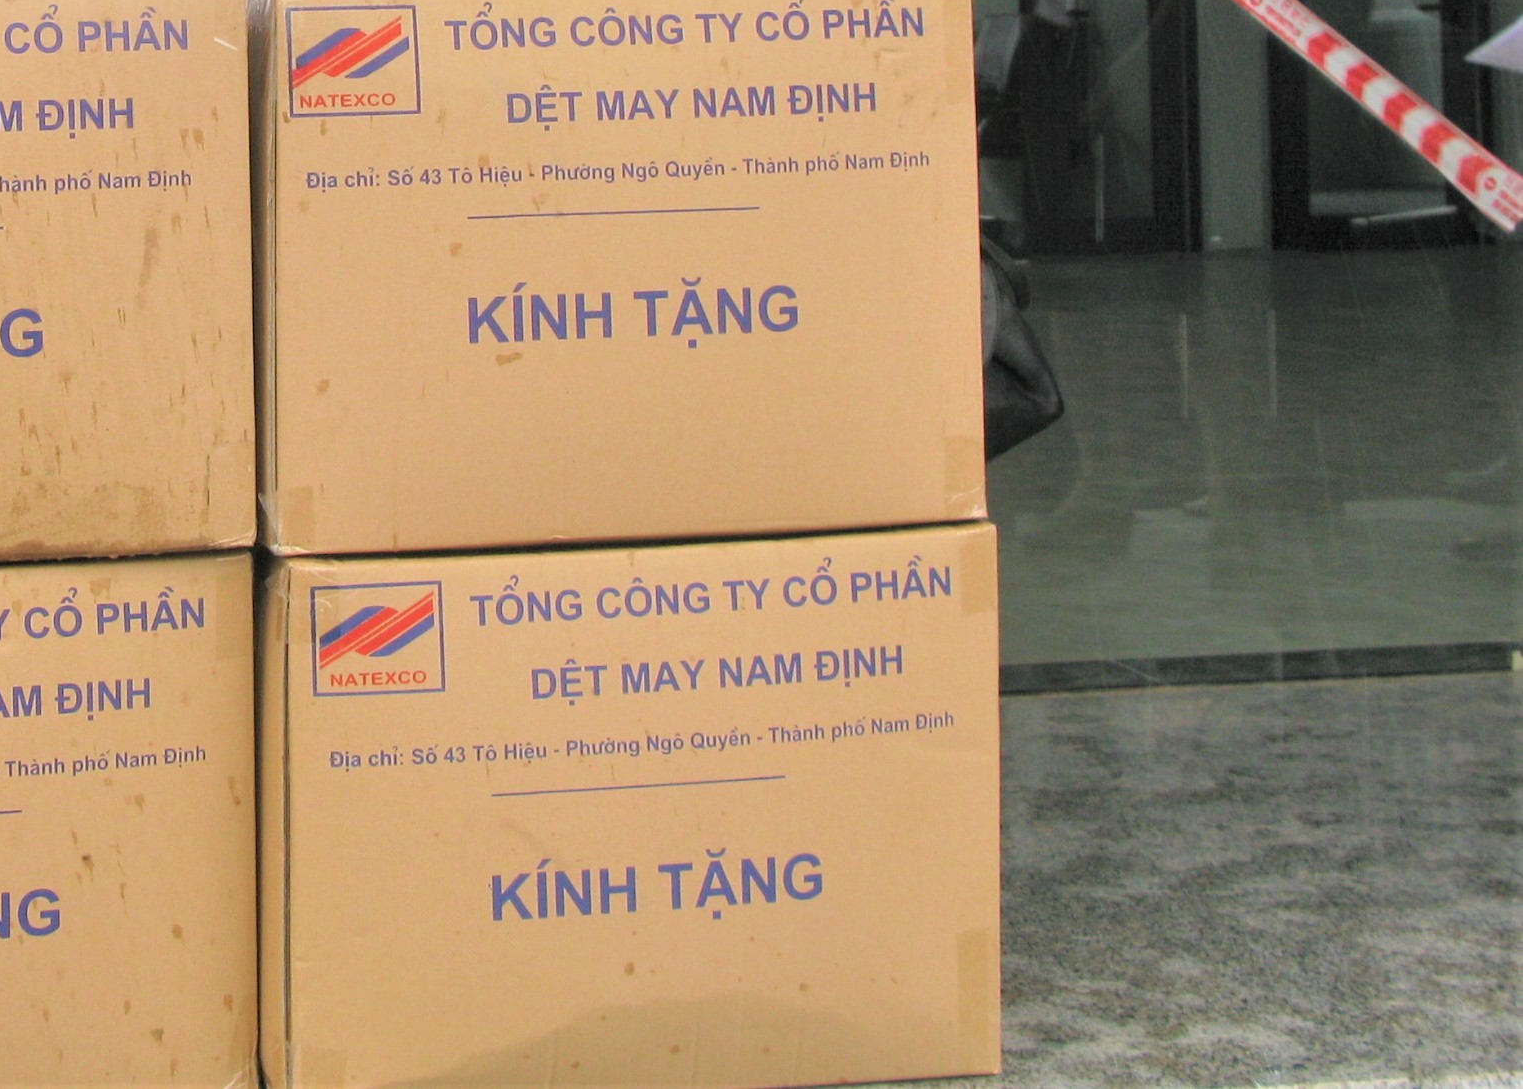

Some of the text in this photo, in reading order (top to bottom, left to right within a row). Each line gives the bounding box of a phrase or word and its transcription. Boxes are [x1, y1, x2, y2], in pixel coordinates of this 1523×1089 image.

[4, 2, 65, 54] CỔ
[78, 6, 189, 51] PHẦN
[445, 1, 557, 50] TỔNG
[570, 5, 685, 46] CÔNG
[697, 11, 743, 43] TY
[37, 96, 134, 138] ĐỊNH
[300, 94, 396, 107] NATEXCO
[507, 81, 877, 130] DỆT MAY NAM ĐỊNH
[53, 172, 93, 194] phố
[98, 173, 142, 189] Nam
[146, 169, 193, 188] Định
[306, 171, 339, 189] Địa
[345, 167, 378, 188] chỉ:
[388, 167, 414, 186] Số
[420, 168, 444, 185] 43
[448, 165, 476, 184] Tô
[480, 167, 524, 184] Hiệu
[542, 162, 617, 183] Phường
[621, 163, 660, 182] Ngô
[666, 158, 726, 180] Quyền
[744, 157, 801, 174] Thành
[805, 153, 841, 174] phố
[845, 154, 884, 170] Nam
[890, 150, 931, 168] Định
[469, 276, 800, 348] KÍNH TẶNG
[24, 586, 84, 639] CỔ
[96, 586, 205, 634] PHẦN
[470, 555, 952, 626] TỔNG CÔNG TY CỔ PHẦN
[55, 677, 151, 721] ĐỊNH
[330, 671, 426, 686] NATEXCO
[532, 644, 904, 705] DỆT MAY NAM ĐỊNH
[5, 759, 67, 776] Thành
[72, 753, 110, 777] phố
[114, 752, 157, 768] Nam
[163, 746, 206, 765] Định
[329, 750, 362, 769] Địa
[368, 750, 404, 767] chỉ:
[412, 746, 438, 766] Số
[444, 746, 466, 763] 43
[473, 744, 498, 762] Tô
[504, 744, 548, 761] Hiệu
[565, 739, 642, 758] Phường
[647, 736, 685, 755] Ngô
[690, 728, 751, 750] Quyền
[769, 725, 825, 743] Thành
[831, 719, 866, 742] phố
[871, 719, 910, 734] Nam
[915, 712, 955, 731] Định
[492, 848, 824, 921] KÍNH TẶNG
